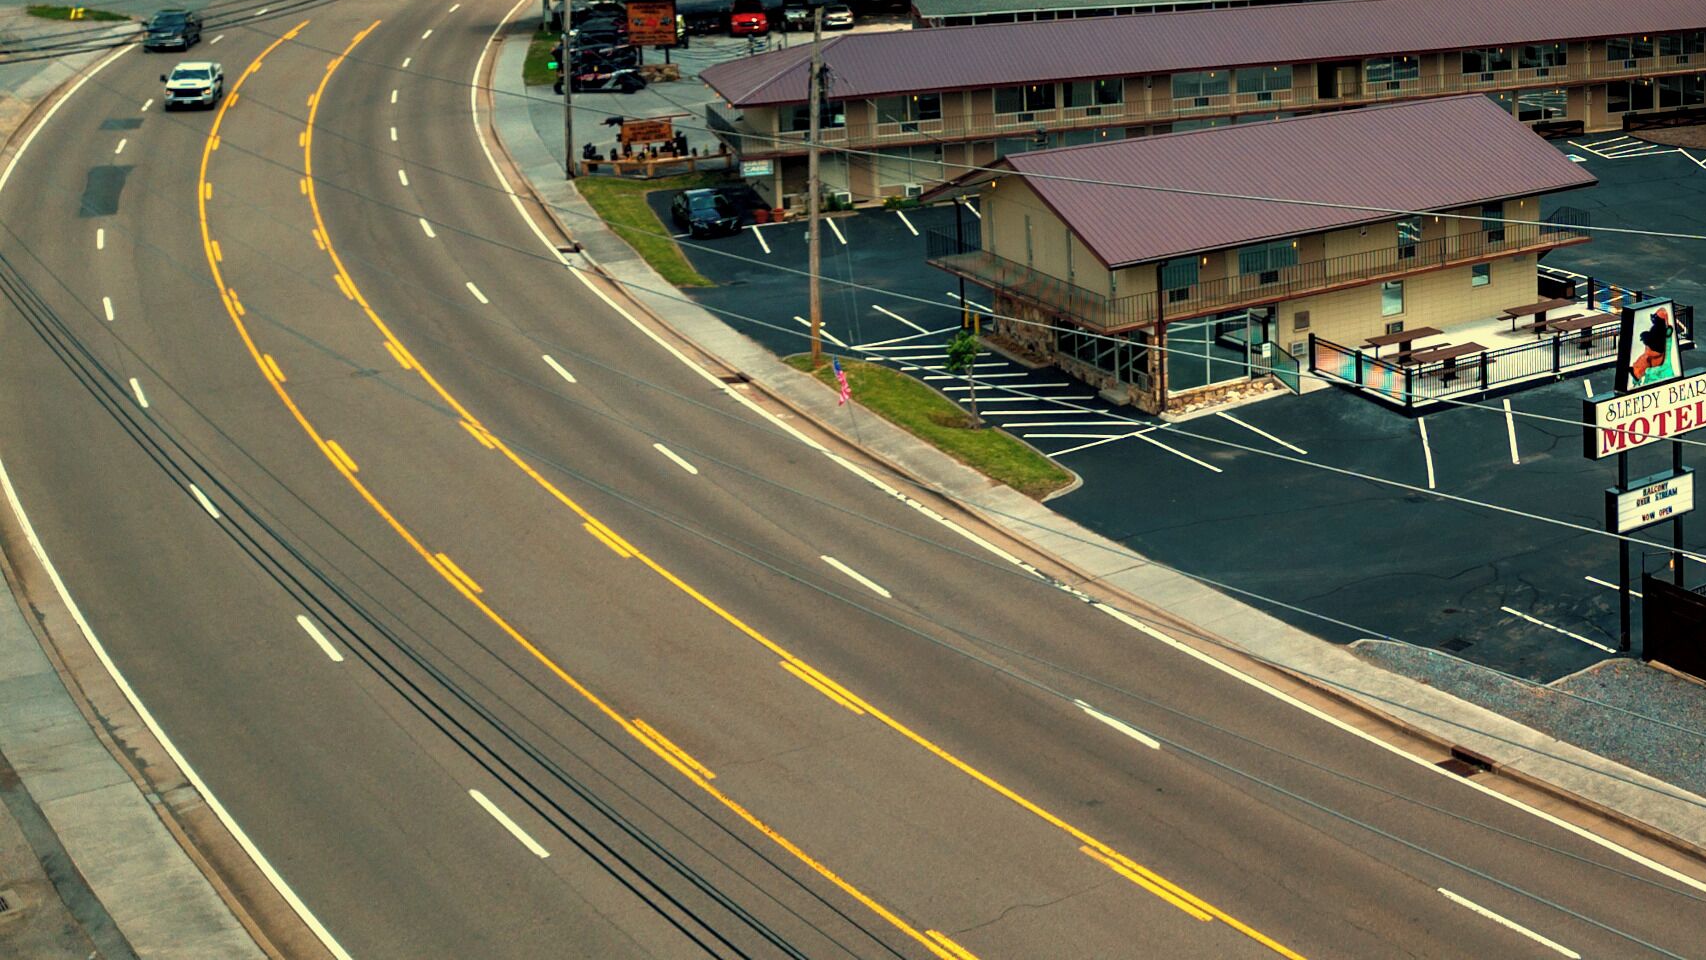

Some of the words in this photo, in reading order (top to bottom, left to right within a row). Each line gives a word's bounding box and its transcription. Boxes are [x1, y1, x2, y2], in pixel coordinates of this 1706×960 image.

[1605, 390, 1660, 422] SLEEPY
[1668, 378, 1706, 404] BEAR
[1643, 481, 1669, 496] BALCONY
[1642, 511, 1656, 522] NOW
[1659, 505, 1673, 517] OPEN
